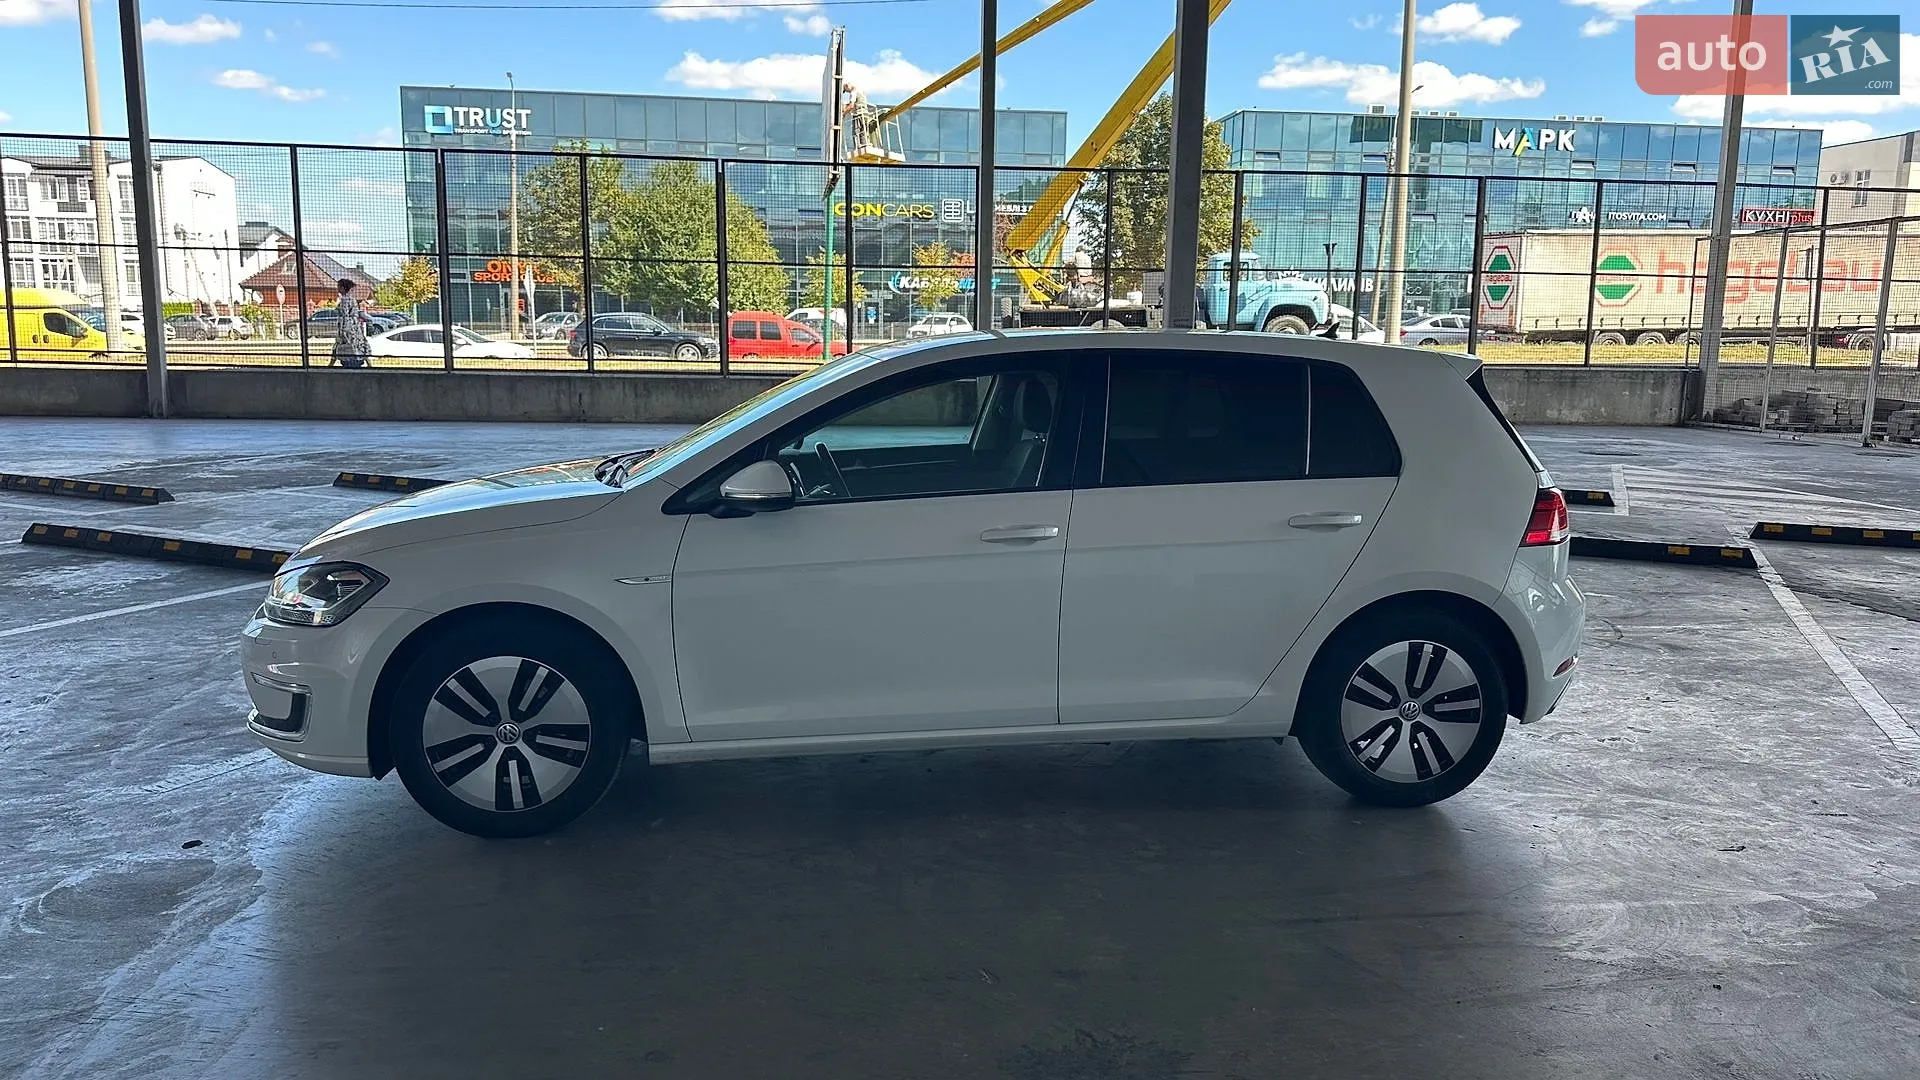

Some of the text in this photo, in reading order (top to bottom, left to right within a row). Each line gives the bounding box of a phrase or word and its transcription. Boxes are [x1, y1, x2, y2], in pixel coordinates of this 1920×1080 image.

[453, 106, 532, 130] TRUST
[1492, 127, 1577, 157] МАРК
[834, 202, 935, 219] CONCARS
[1790, 213, 1814, 224] plus
